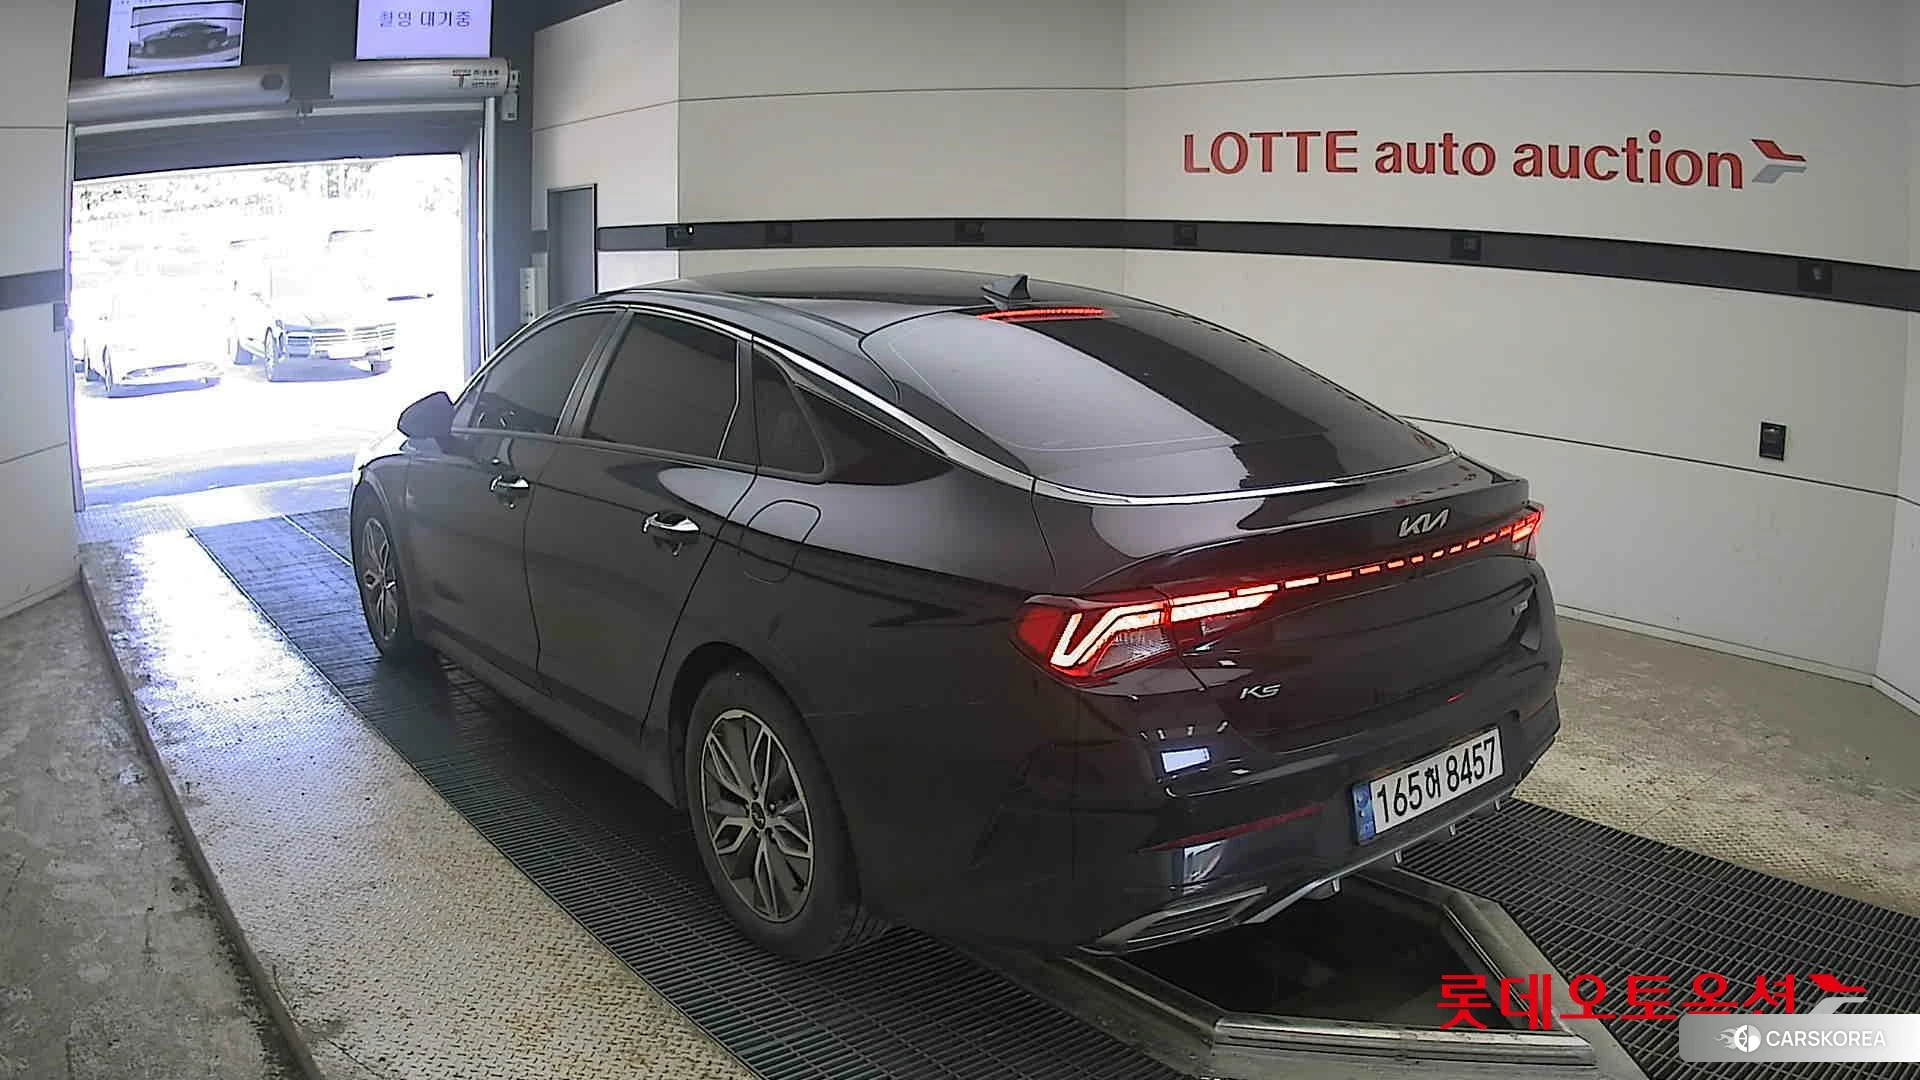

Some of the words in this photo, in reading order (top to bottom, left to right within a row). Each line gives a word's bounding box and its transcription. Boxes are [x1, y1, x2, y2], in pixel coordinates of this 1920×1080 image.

[420, 11, 471, 27] 대기중
[1183, 130, 1358, 174] LOTTE
[1374, 132, 1496, 176] auto
[1512, 130, 1743, 189] auction
[1239, 683, 1281, 699] K5
[1376, 764, 1441, 823] 165허
[1446, 736, 1496, 793] 8457
